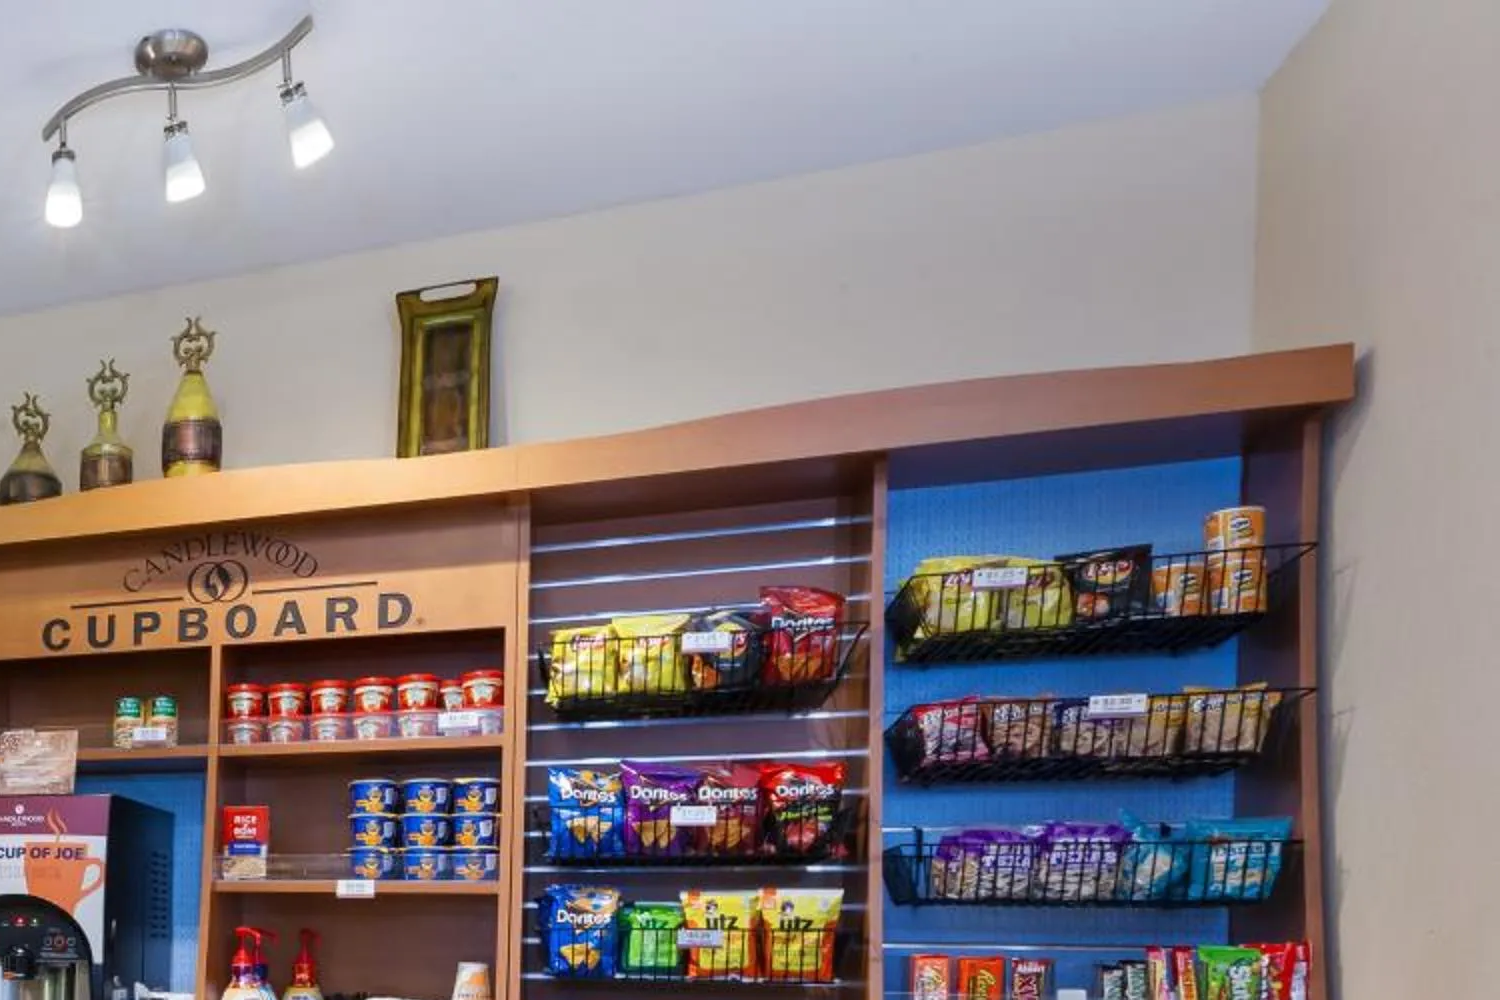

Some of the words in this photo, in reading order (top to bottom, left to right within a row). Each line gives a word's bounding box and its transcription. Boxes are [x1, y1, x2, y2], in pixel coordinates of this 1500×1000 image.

[122, 529, 319, 593] CANDLEWOOD
[42, 592, 414, 652] CUPBOARD
[30, 848, 52, 860] OF
[55, 848, 85, 860] JOE
